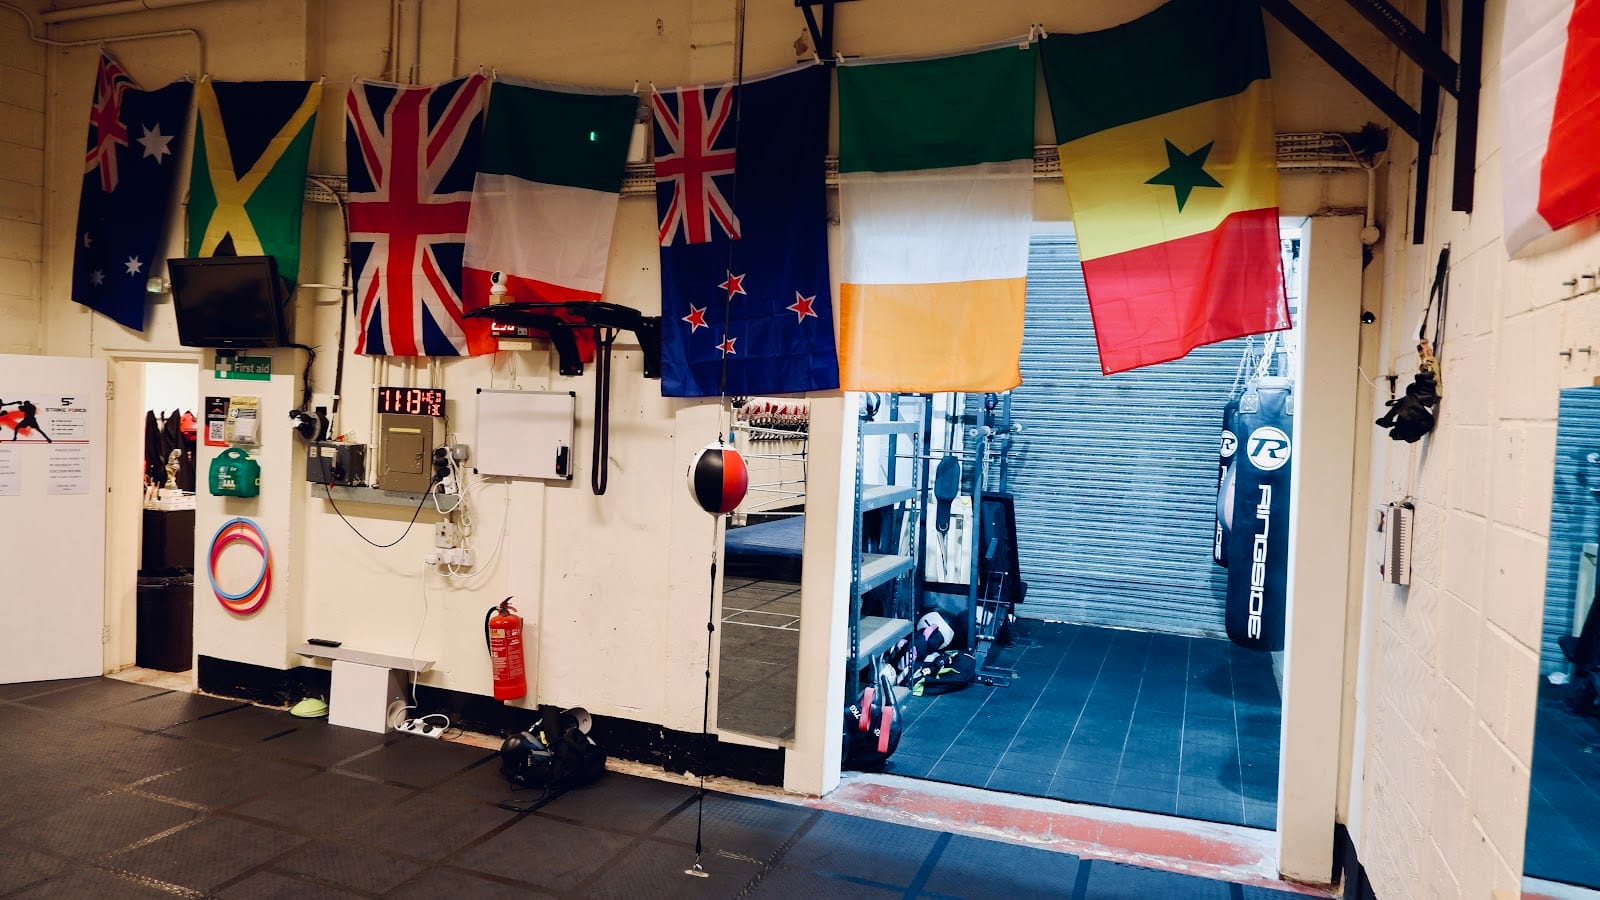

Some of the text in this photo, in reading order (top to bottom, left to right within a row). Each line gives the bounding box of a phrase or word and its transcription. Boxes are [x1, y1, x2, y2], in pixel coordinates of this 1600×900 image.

[234, 362, 270, 374] First aid
[1247, 484, 1272, 640] RINGSIDE
